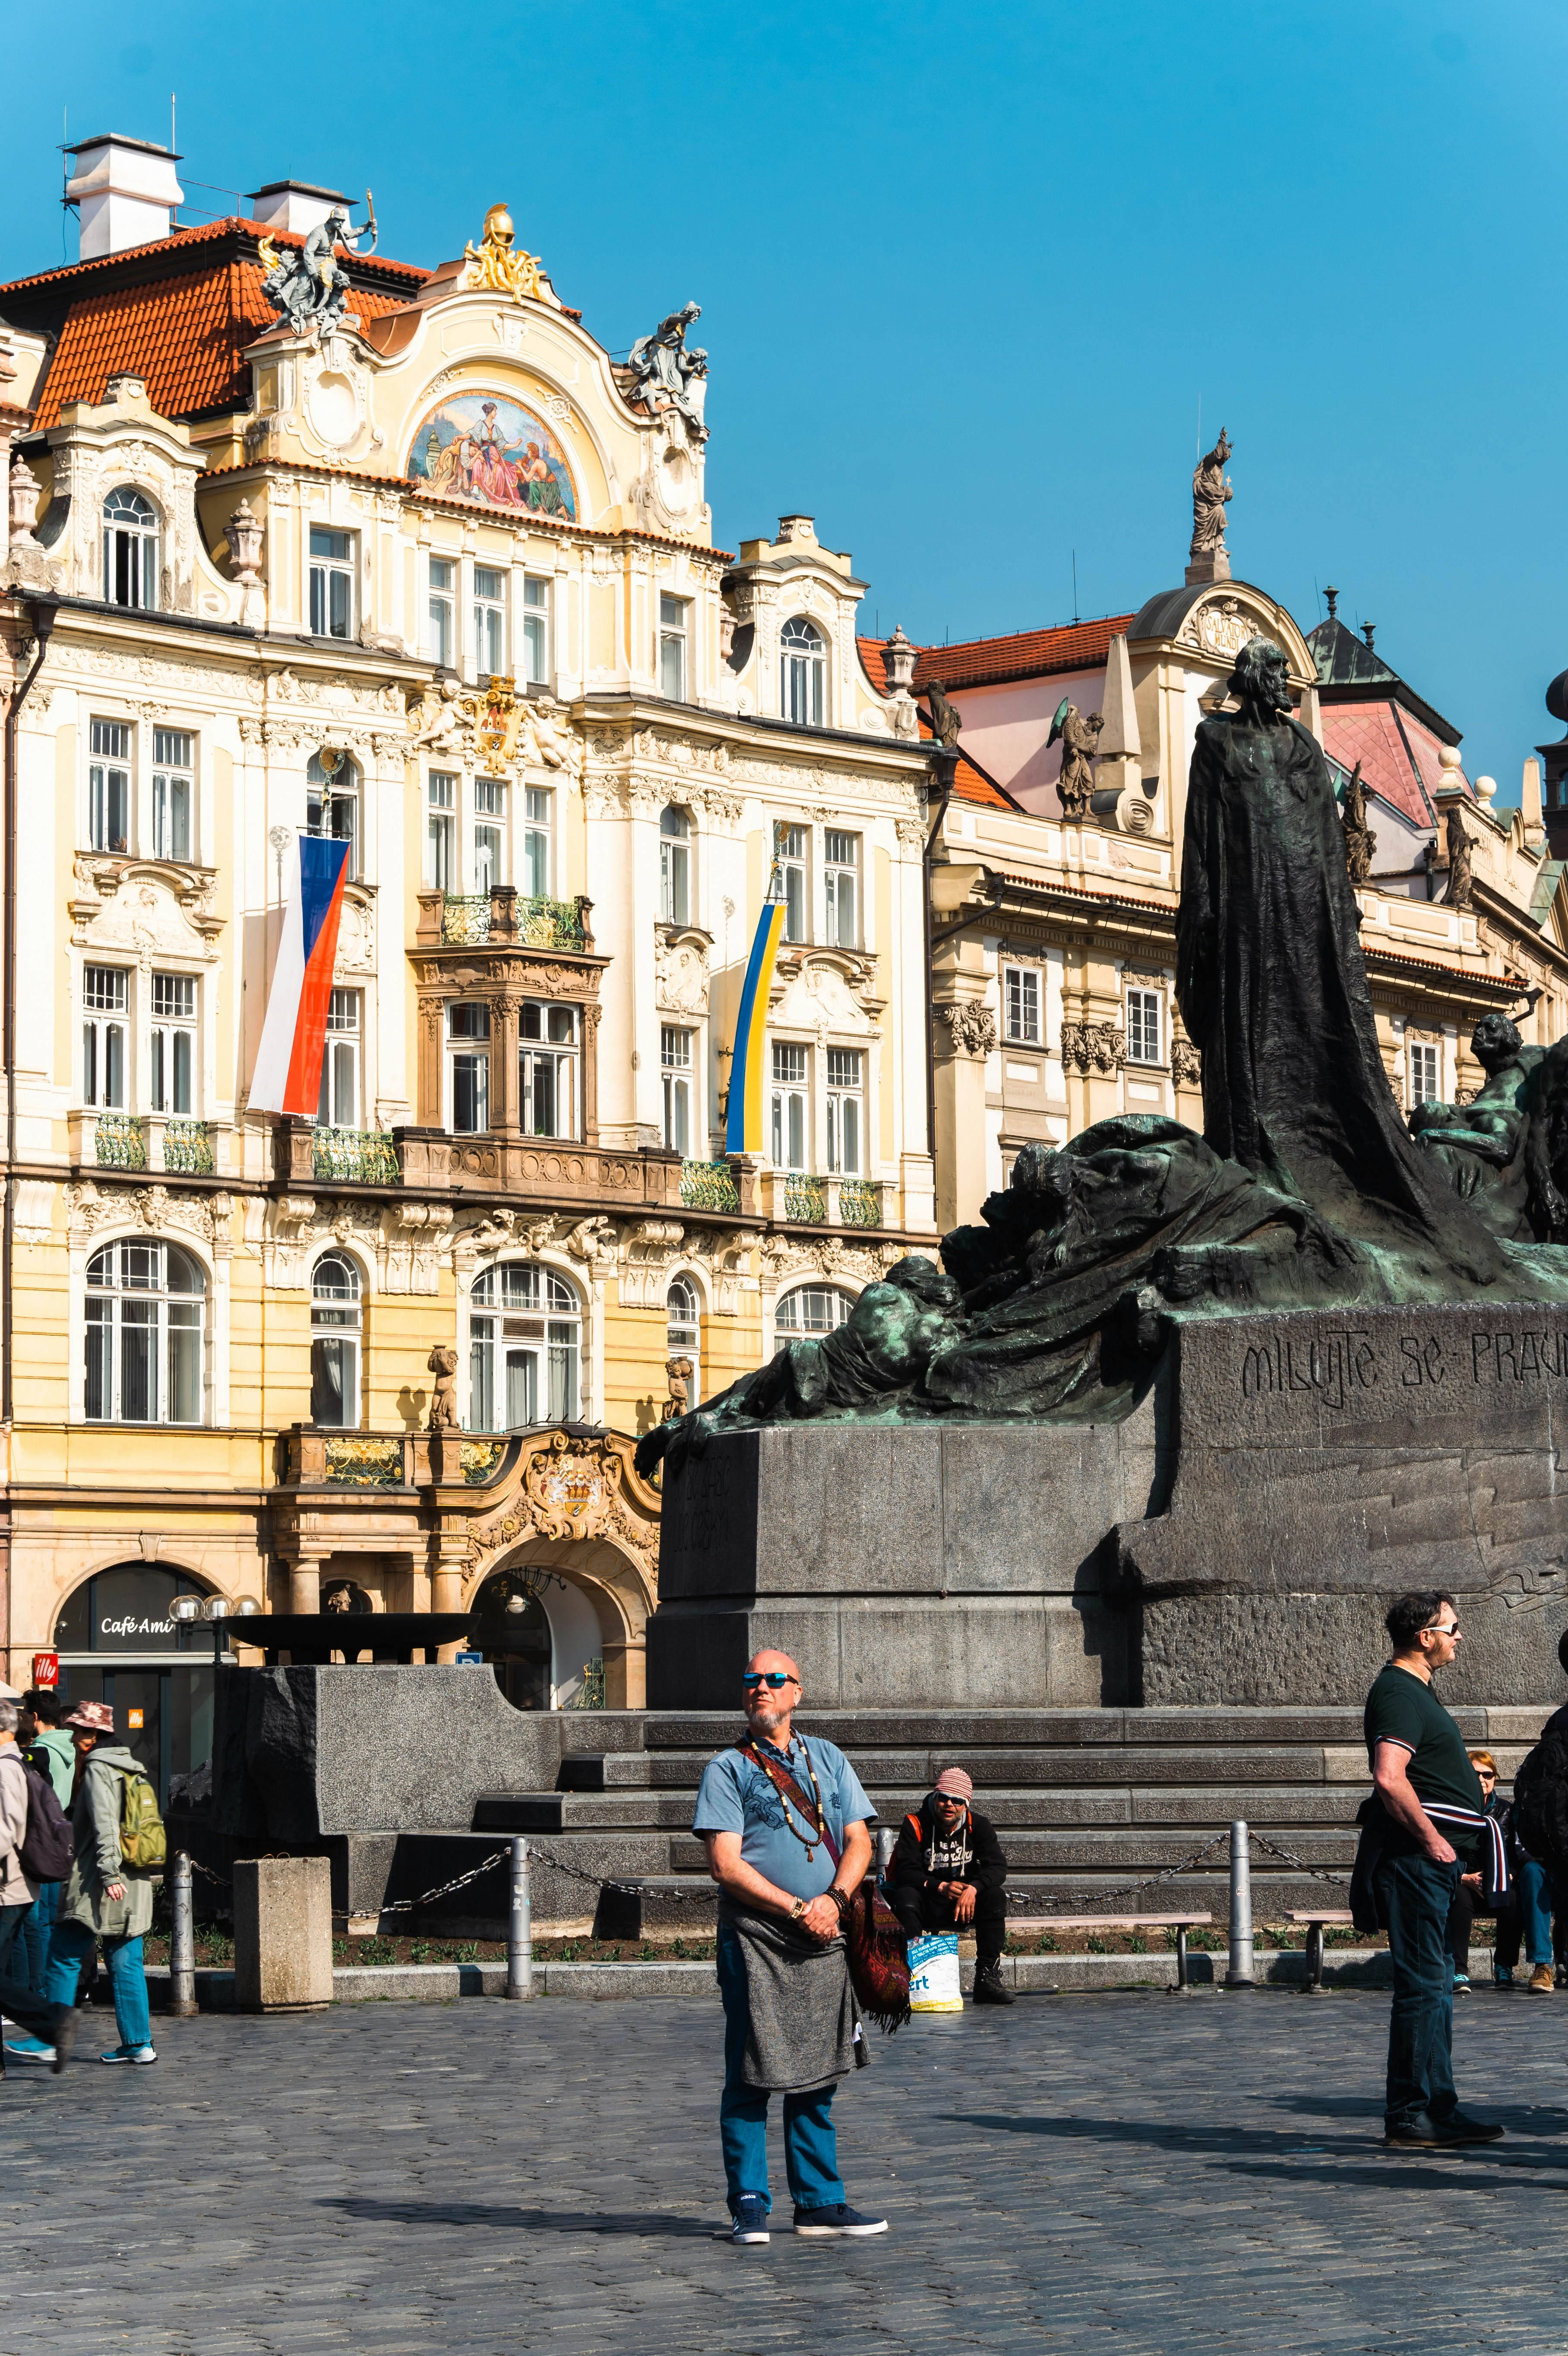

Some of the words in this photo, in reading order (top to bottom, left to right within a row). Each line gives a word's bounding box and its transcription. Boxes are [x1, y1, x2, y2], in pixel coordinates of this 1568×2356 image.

[1206, 616, 1246, 640] SALVATOR
[1214, 633, 1239, 653] MUNDI
[1400, 1336, 1445, 1386] SE
[1471, 1331, 1568, 1384] PRAV
[101, 1616, 138, 1636] Café
[36, 1657, 56, 1682] illy
[130, 1712, 142, 1726] illy
